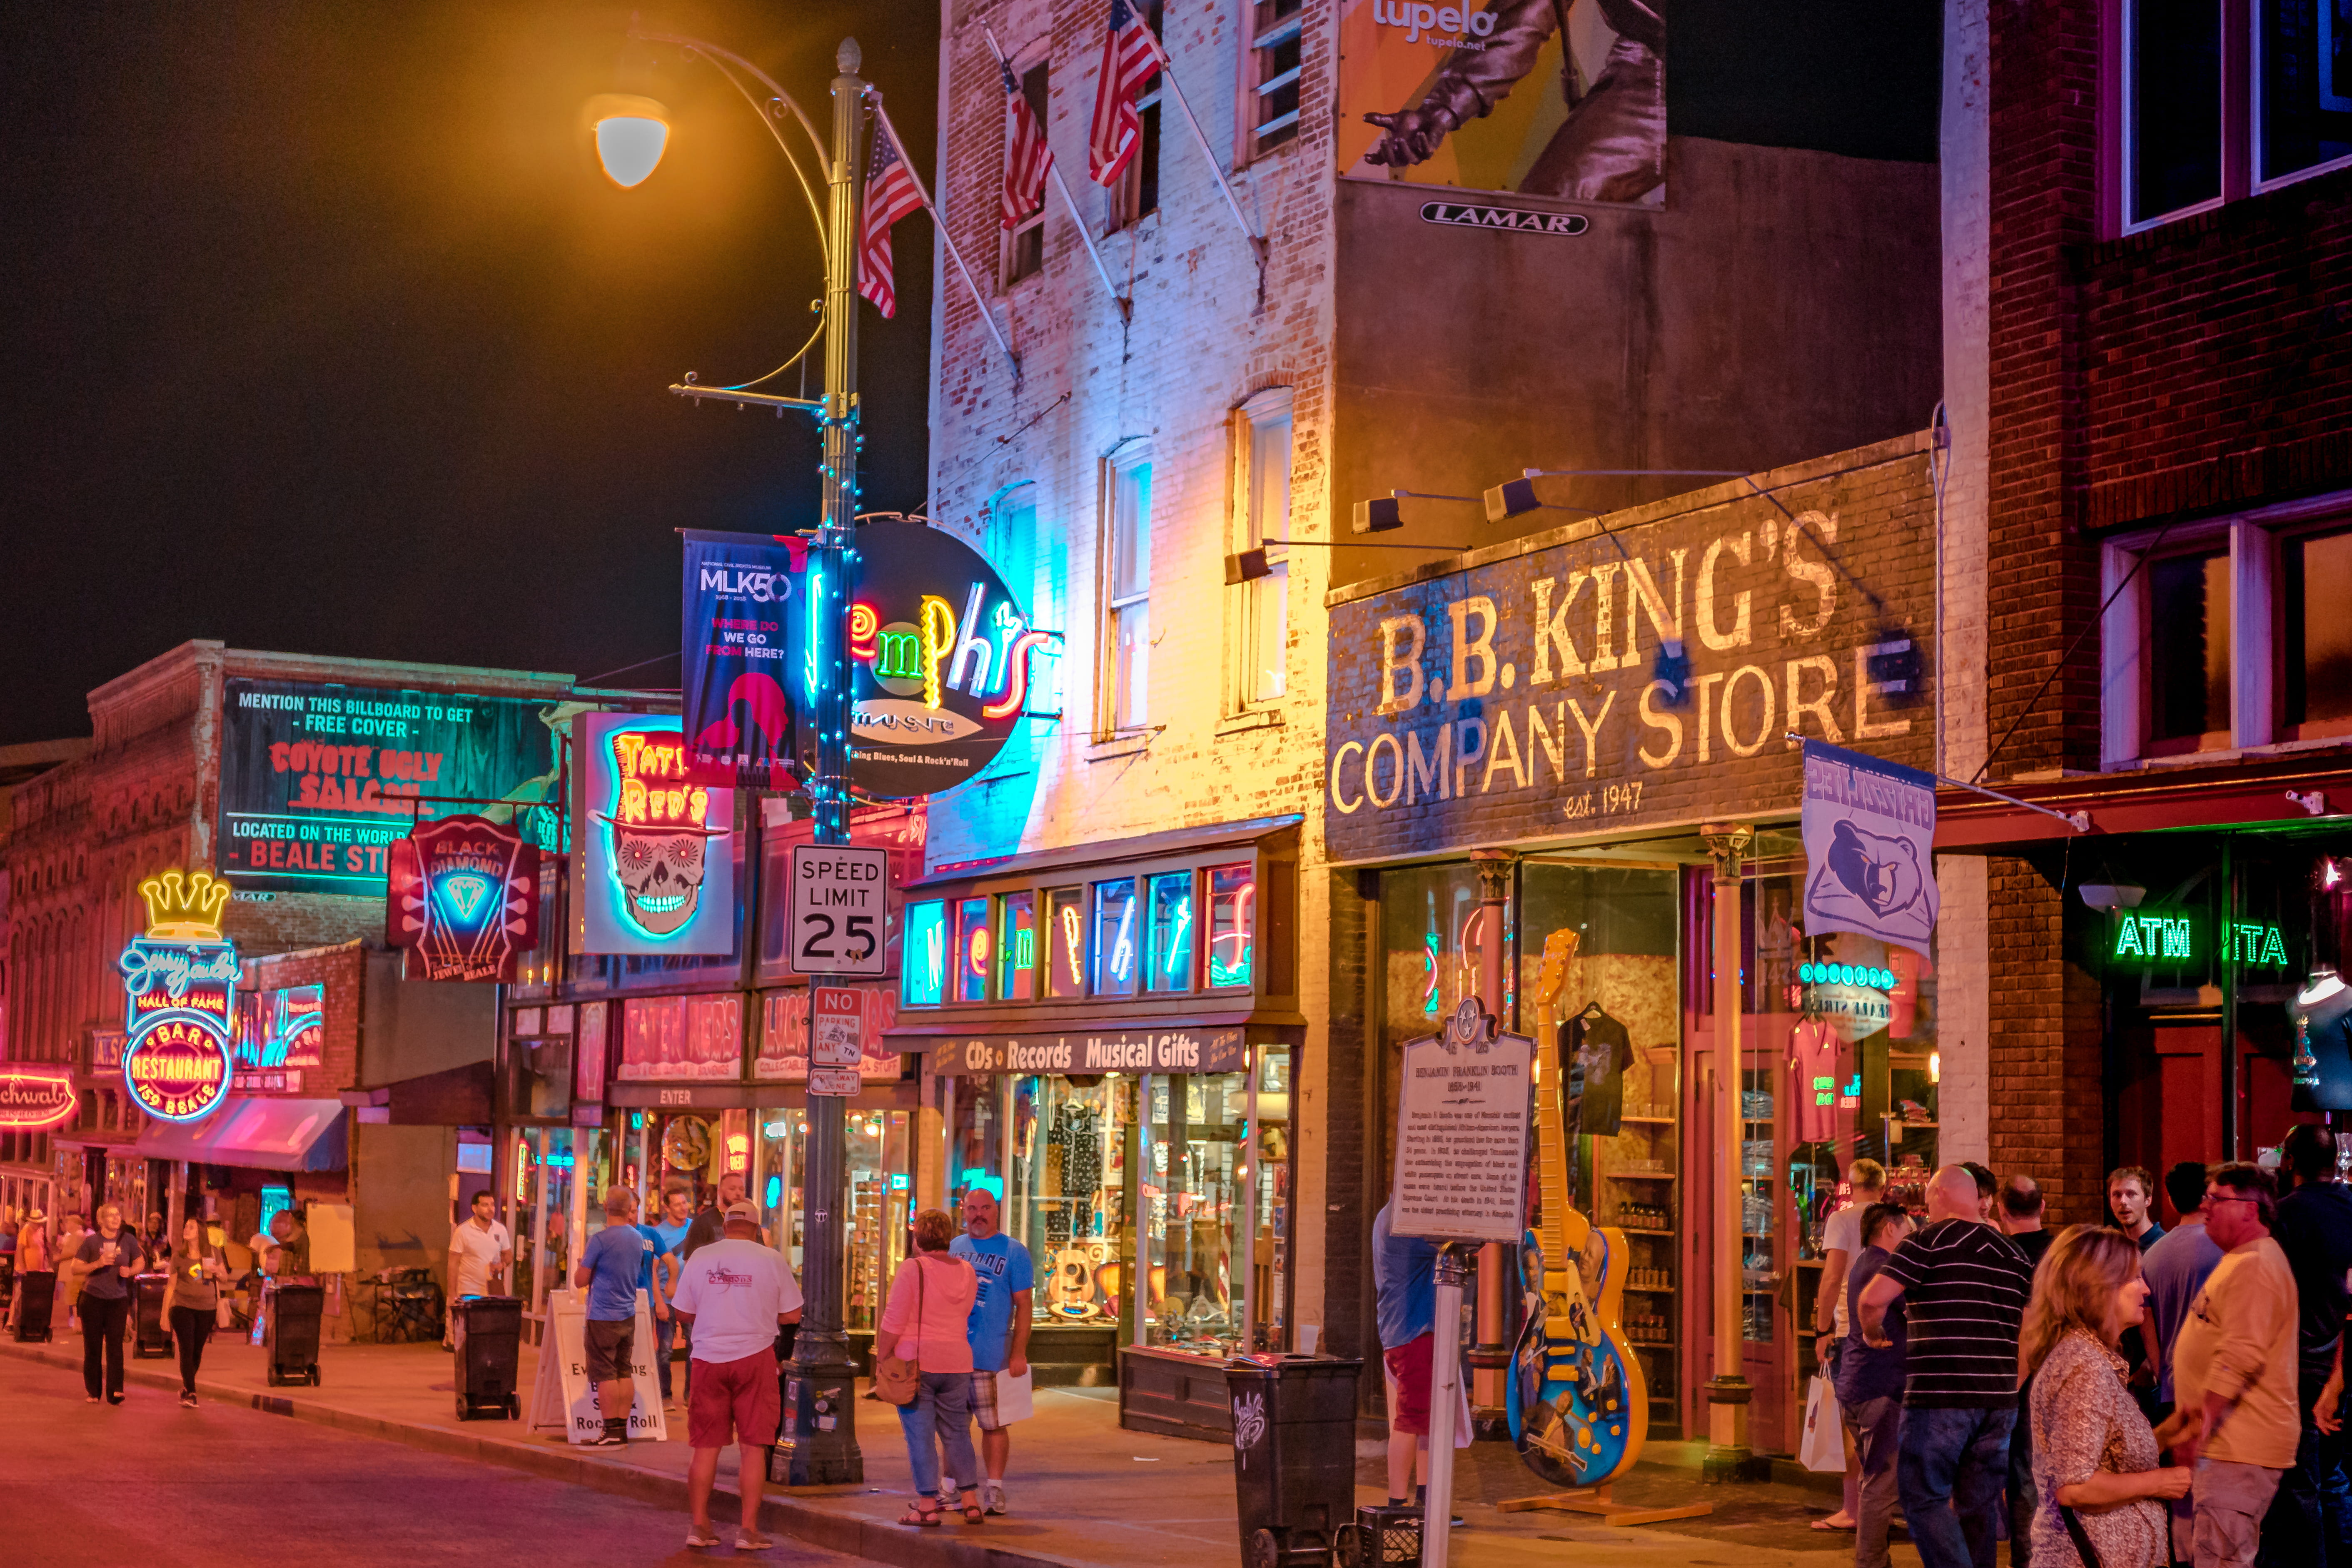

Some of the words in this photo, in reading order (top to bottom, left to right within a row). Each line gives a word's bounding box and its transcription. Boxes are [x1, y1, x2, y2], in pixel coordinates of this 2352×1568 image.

[1426, 34, 1486, 51] tupelo.net
[1434, 205, 1571, 232] LAMAR
[701, 569, 792, 603] MLK50
[1377, 595, 1516, 716] B.B.
[1530, 509, 1838, 686] KING'S
[711, 618, 757, 631] WHERE
[760, 621, 779, 632] DO
[724, 632, 744, 643] WE
[747, 634, 766, 644] GO
[706, 645, 742, 656] FROM
[745, 647, 784, 659] HERE?
[239, 692, 304, 711] MENTION
[309, 697, 341, 714] THIS
[346, 700, 420, 720] BILLBOARD
[424, 705, 443, 720] TO
[446, 707, 474, 723] GET
[305, 714, 346, 733] FREE
[352, 717, 407, 738] COVER
[1331, 690, 1616, 815] COMPANY
[1639, 639, 1913, 769] STORE
[269, 740, 373, 777] COYOTE
[379, 749, 443, 781] UGLY
[873, 752, 897, 763] Blues,
[899, 754, 916, 763] Soul
[917, 755, 923, 764] &
[622, 779, 707, 822] RED'S
[1563, 789, 1596, 820] est.
[1602, 780, 1643, 815] 1947
[233, 822, 294, 839] LOCATED
[300, 825, 319, 840] ON
[324, 826, 351, 842] THE
[251, 840, 335, 870] BEALE
[436, 840, 499, 855] BLACK
[430, 856, 504, 877] DIAMOND
[801, 860, 879, 881] SPEED
[810, 887, 870, 907] LIMIT
[801, 913, 876, 960] 25
[2116, 917, 2191, 957] ATM
[138, 996, 169, 1008] HALL
[171, 997, 187, 1008] OF
[191, 997, 224, 1010] FAME
[825, 993, 853, 1010] NO
[819, 1017, 856, 1028] PARKING
[157, 1022, 201, 1045] BAR
[843, 1046, 855, 1057] TN
[965, 1040, 993, 1070] CDs
[1007, 1037, 1072, 1070] Records
[1085, 1035, 1153, 1068] Musical
[1157, 1032, 1200, 1067] Gifts
[1446, 1042, 1457, 1055] 4E
[1475, 1041, 1489, 1054] 126
[132, 1057, 222, 1080] RESTAURANT
[874, 1059, 897, 1073] STUFF
[1416, 1067, 1449, 1078] BENJAMIN
[1453, 1066, 1489, 1077] FRANKLIN
[1491, 1064, 1519, 1076] BOOTH
[0, 1082, 63, 1104] chwab
[137, 1084, 160, 1106] 159
[166, 1084, 216, 1114] BEALE
[660, 1089, 691, 1104] ENTER
[577, 1417, 603, 1430] Roc
[630, 1415, 657, 1428] Roll
